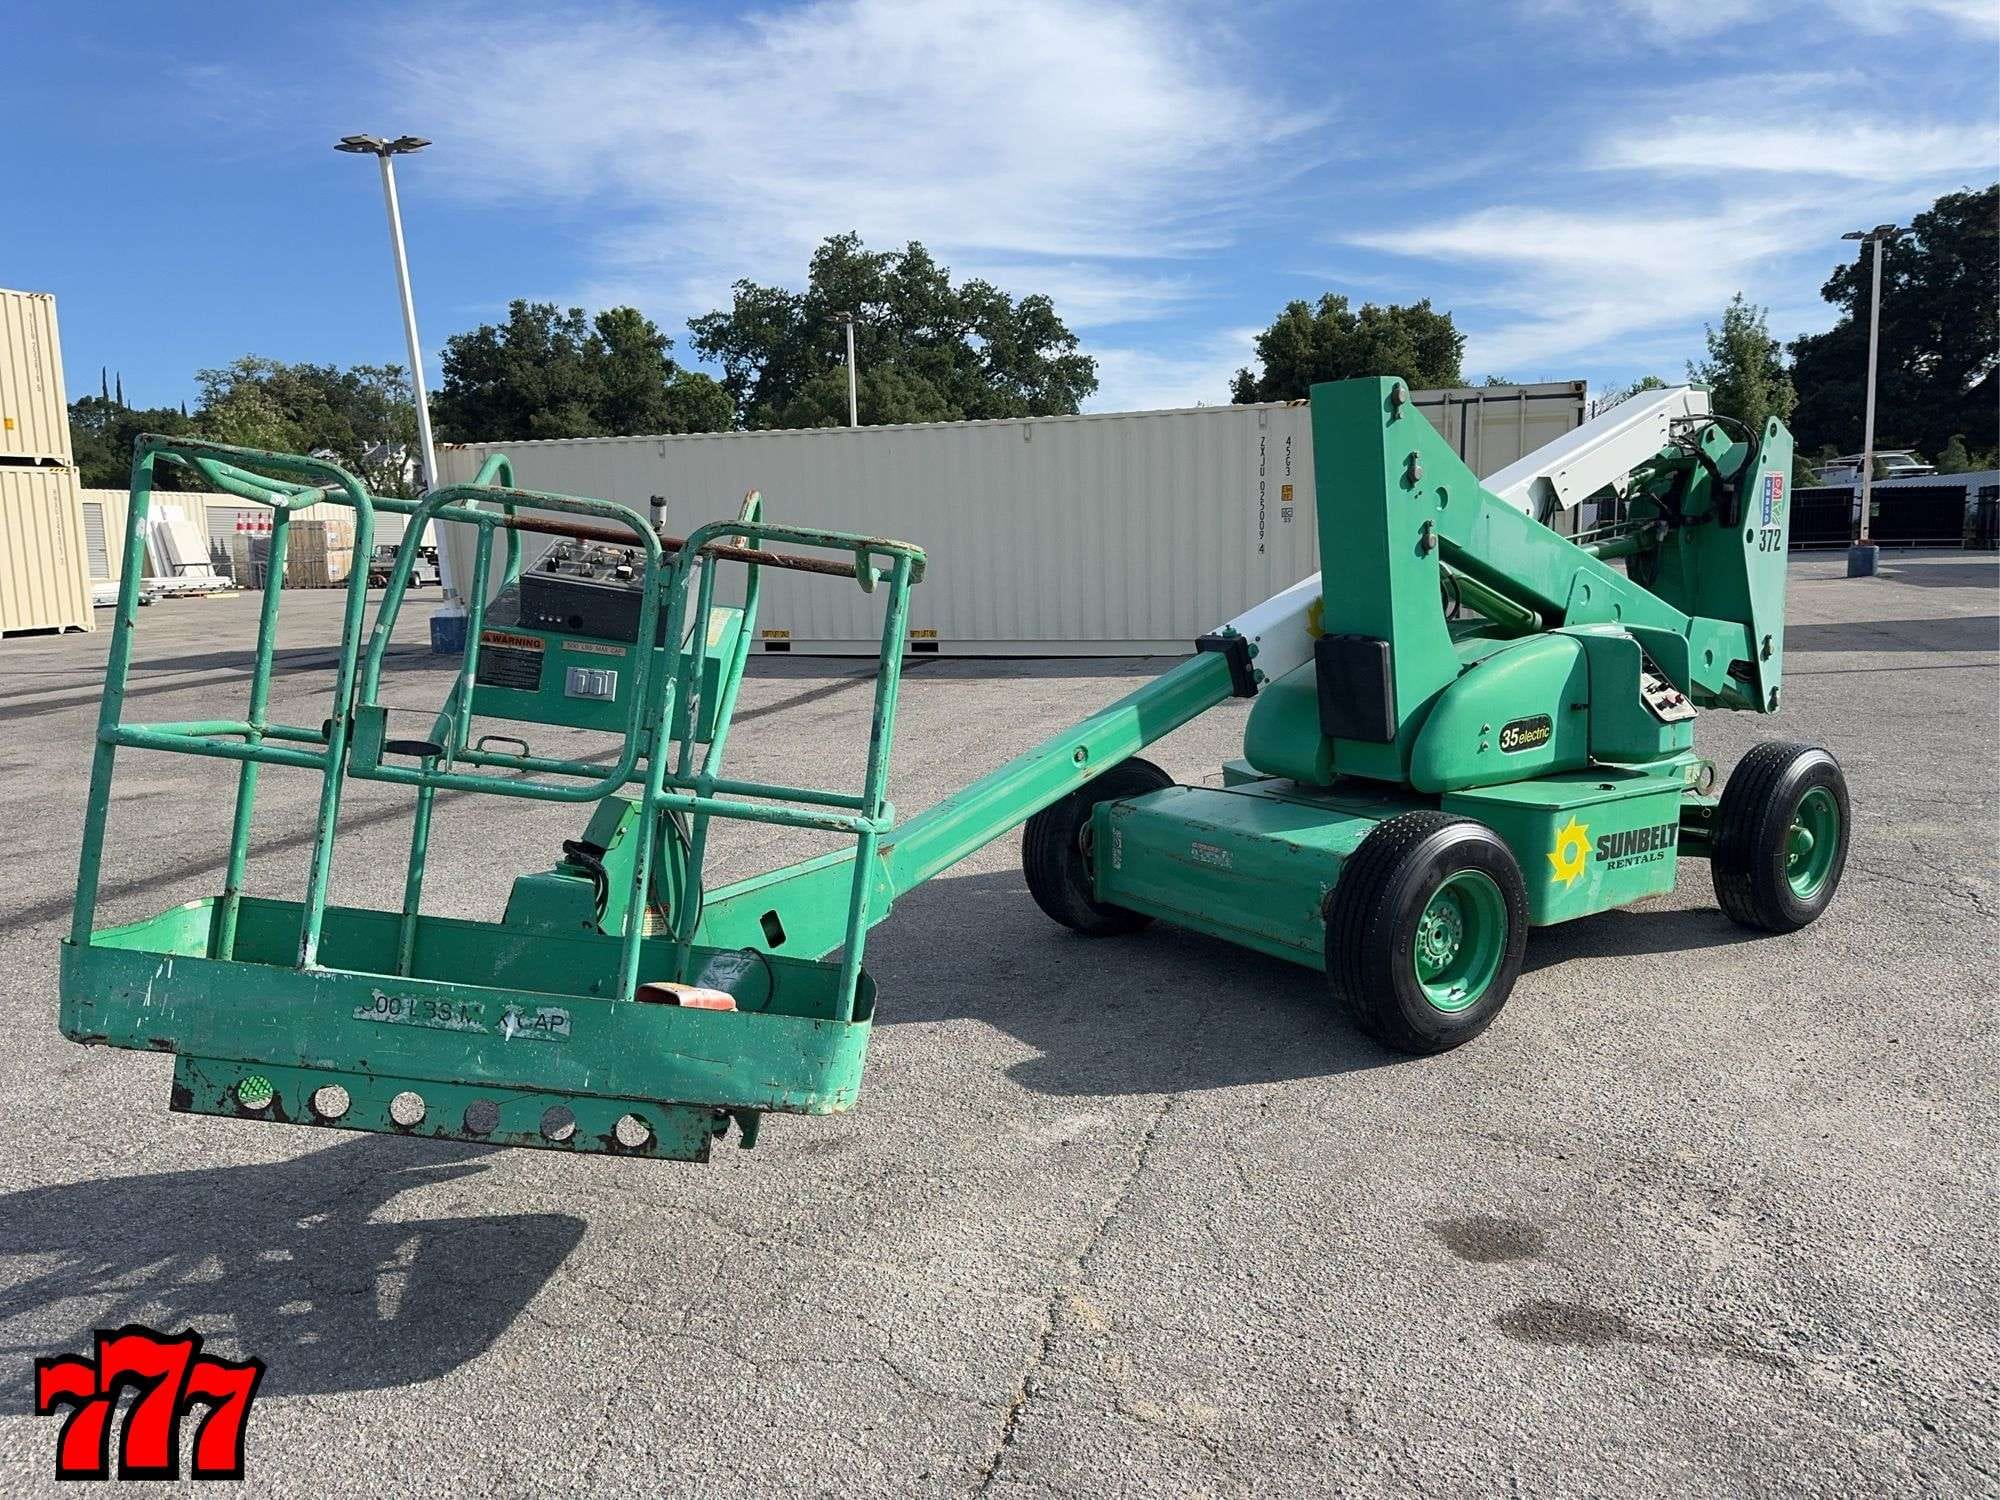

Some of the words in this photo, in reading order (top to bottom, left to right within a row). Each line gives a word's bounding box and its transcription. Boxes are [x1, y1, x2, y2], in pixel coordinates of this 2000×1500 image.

[1258, 543, 1265, 555] 4
[1759, 529, 1782, 552] 372
[493, 634, 541, 648] WARNING
[1596, 822, 1679, 862] SUNBELT
[1607, 851, 1665, 871] RENTALS
